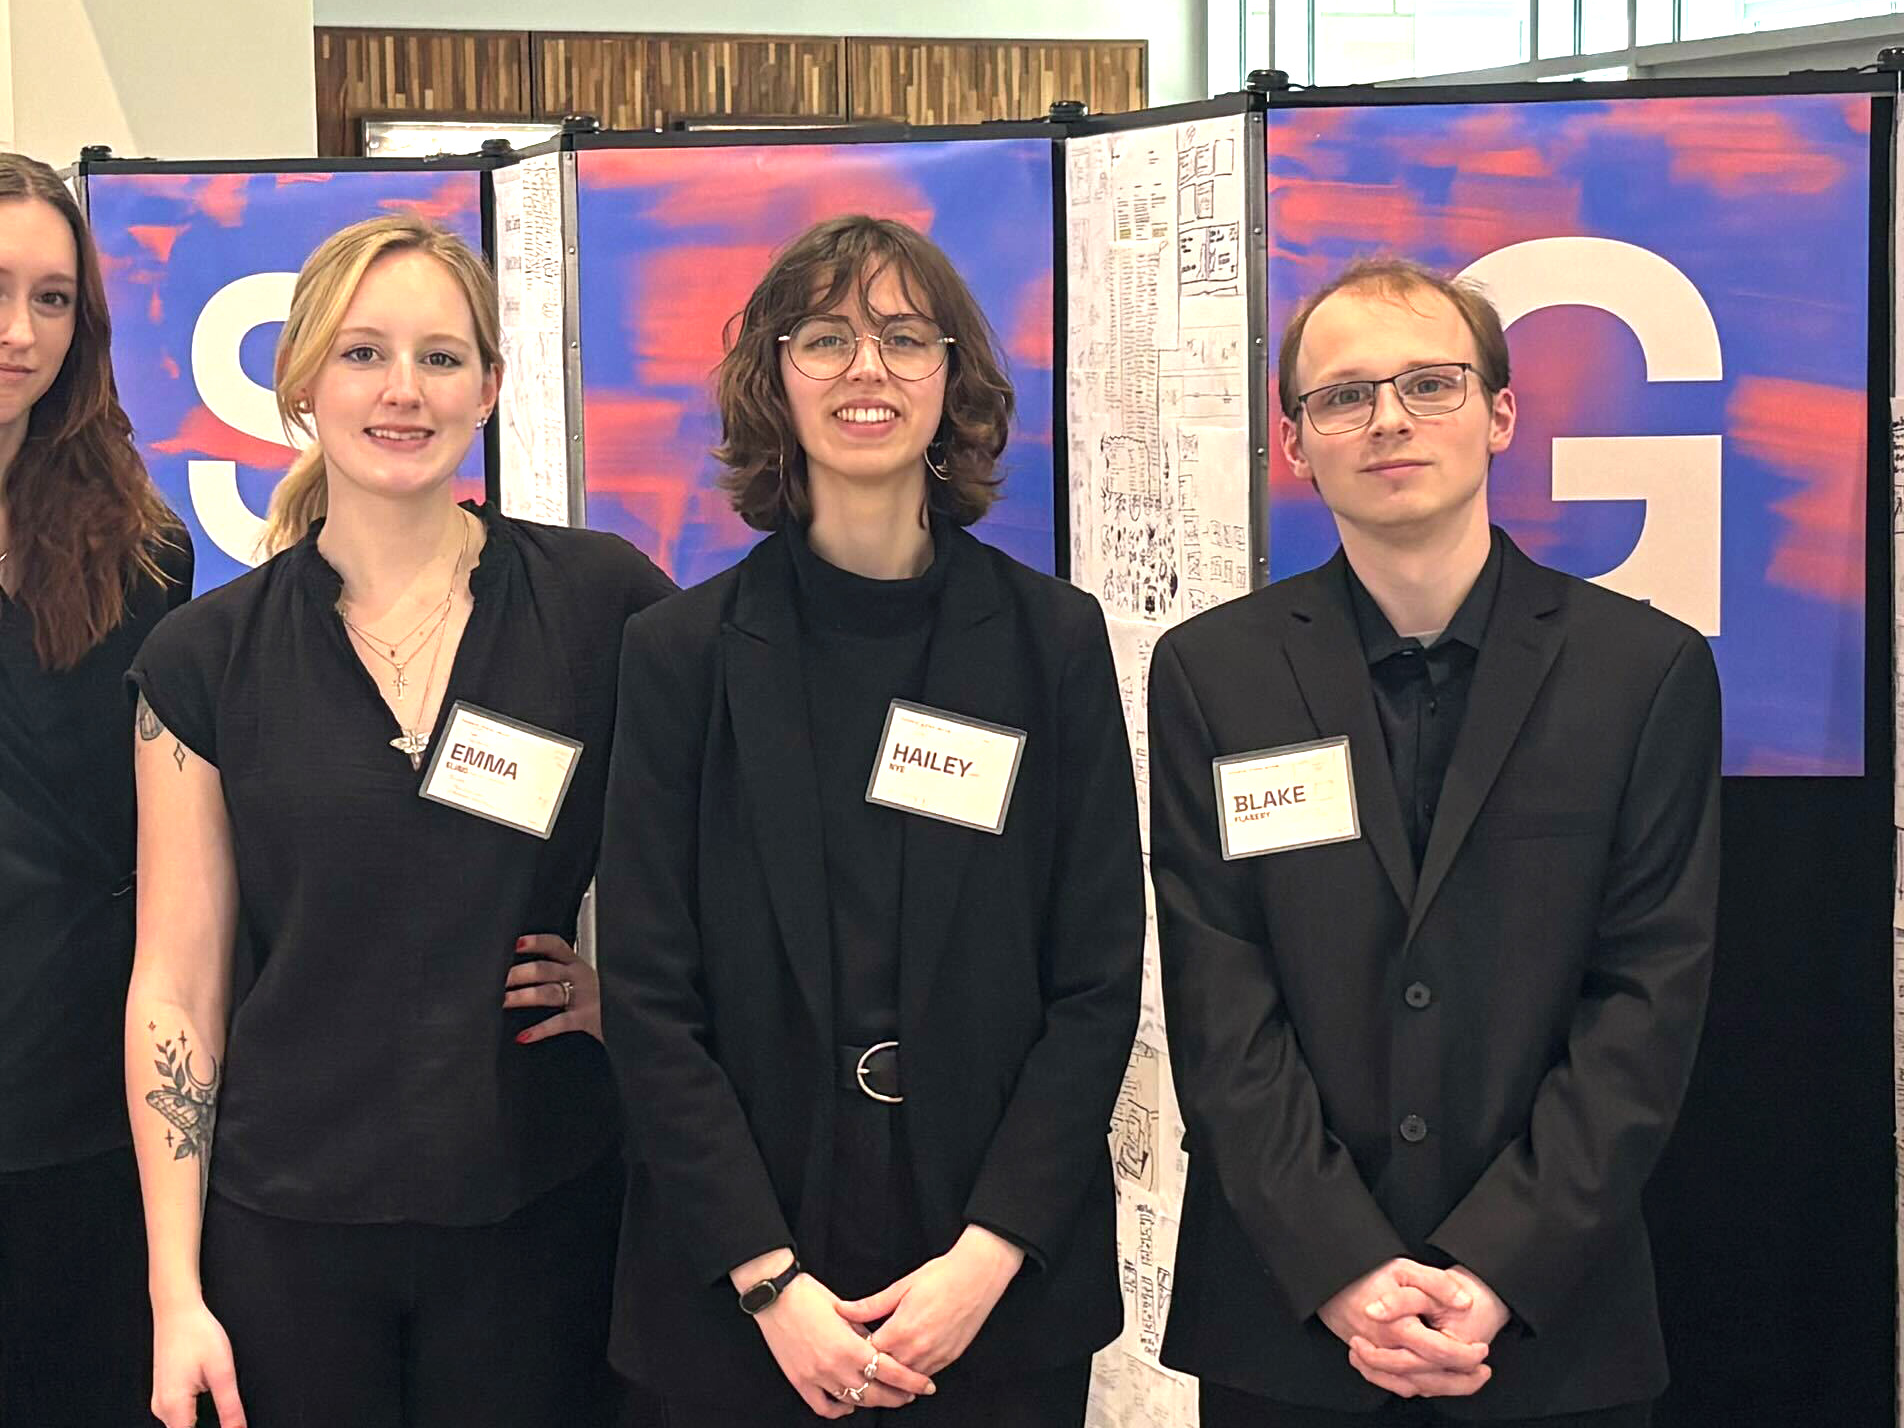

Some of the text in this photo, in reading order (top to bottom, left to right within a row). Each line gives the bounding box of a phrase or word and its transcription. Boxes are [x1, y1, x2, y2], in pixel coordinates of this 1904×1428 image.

[1456, 236, 1724, 638] G
[451, 742, 518, 780] EMMA
[892, 743, 973, 778] HAILEY
[1233, 785, 1306, 813] BLAKE
